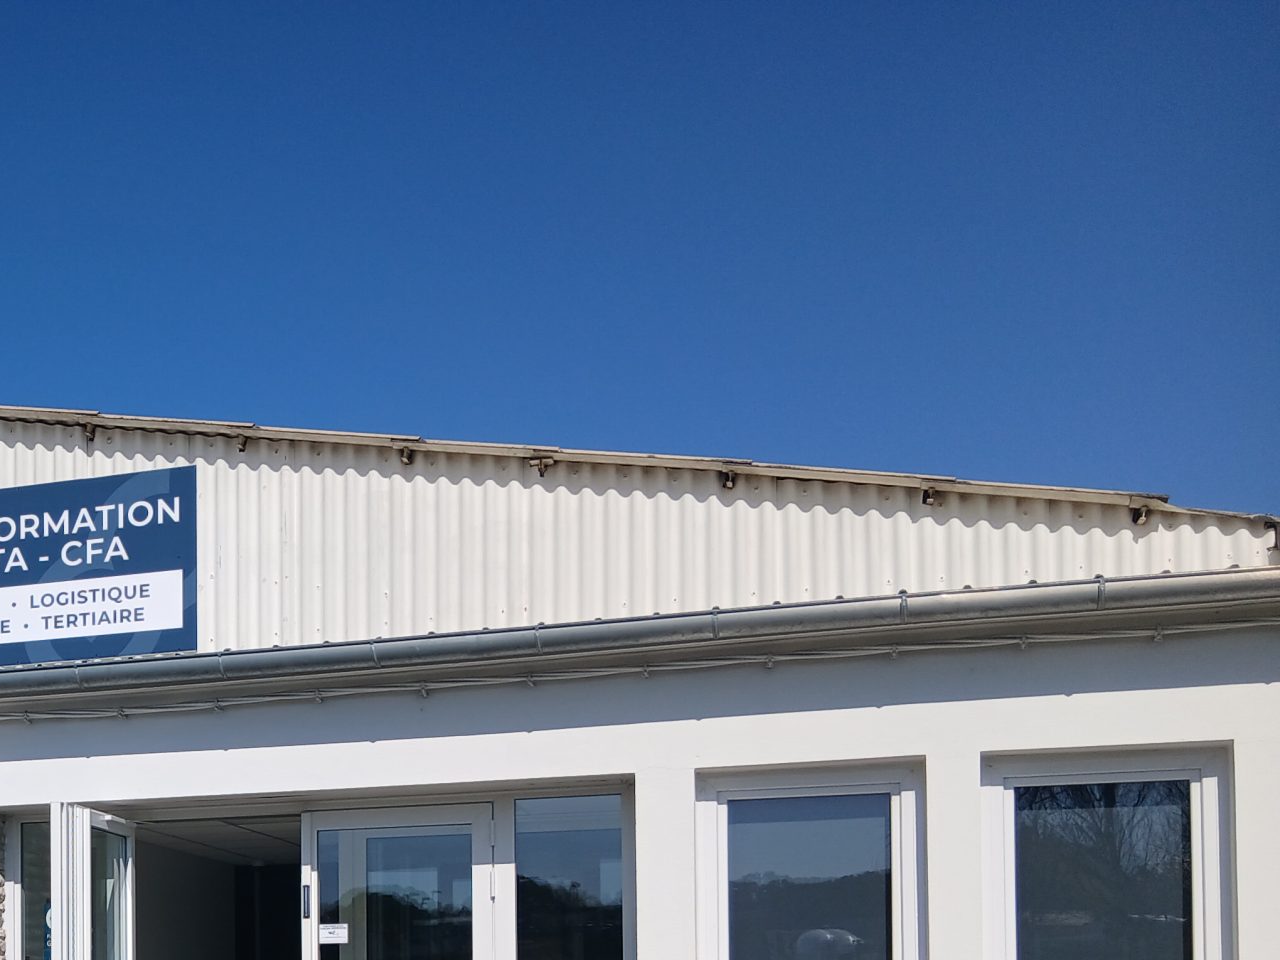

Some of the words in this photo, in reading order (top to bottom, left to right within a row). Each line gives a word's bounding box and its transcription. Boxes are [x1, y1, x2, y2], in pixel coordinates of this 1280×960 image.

[60, 536, 130, 567] CFA
[29, 584, 151, 609] LOGISTIQUE
[41, 607, 145, 631] TERTIAIRE
